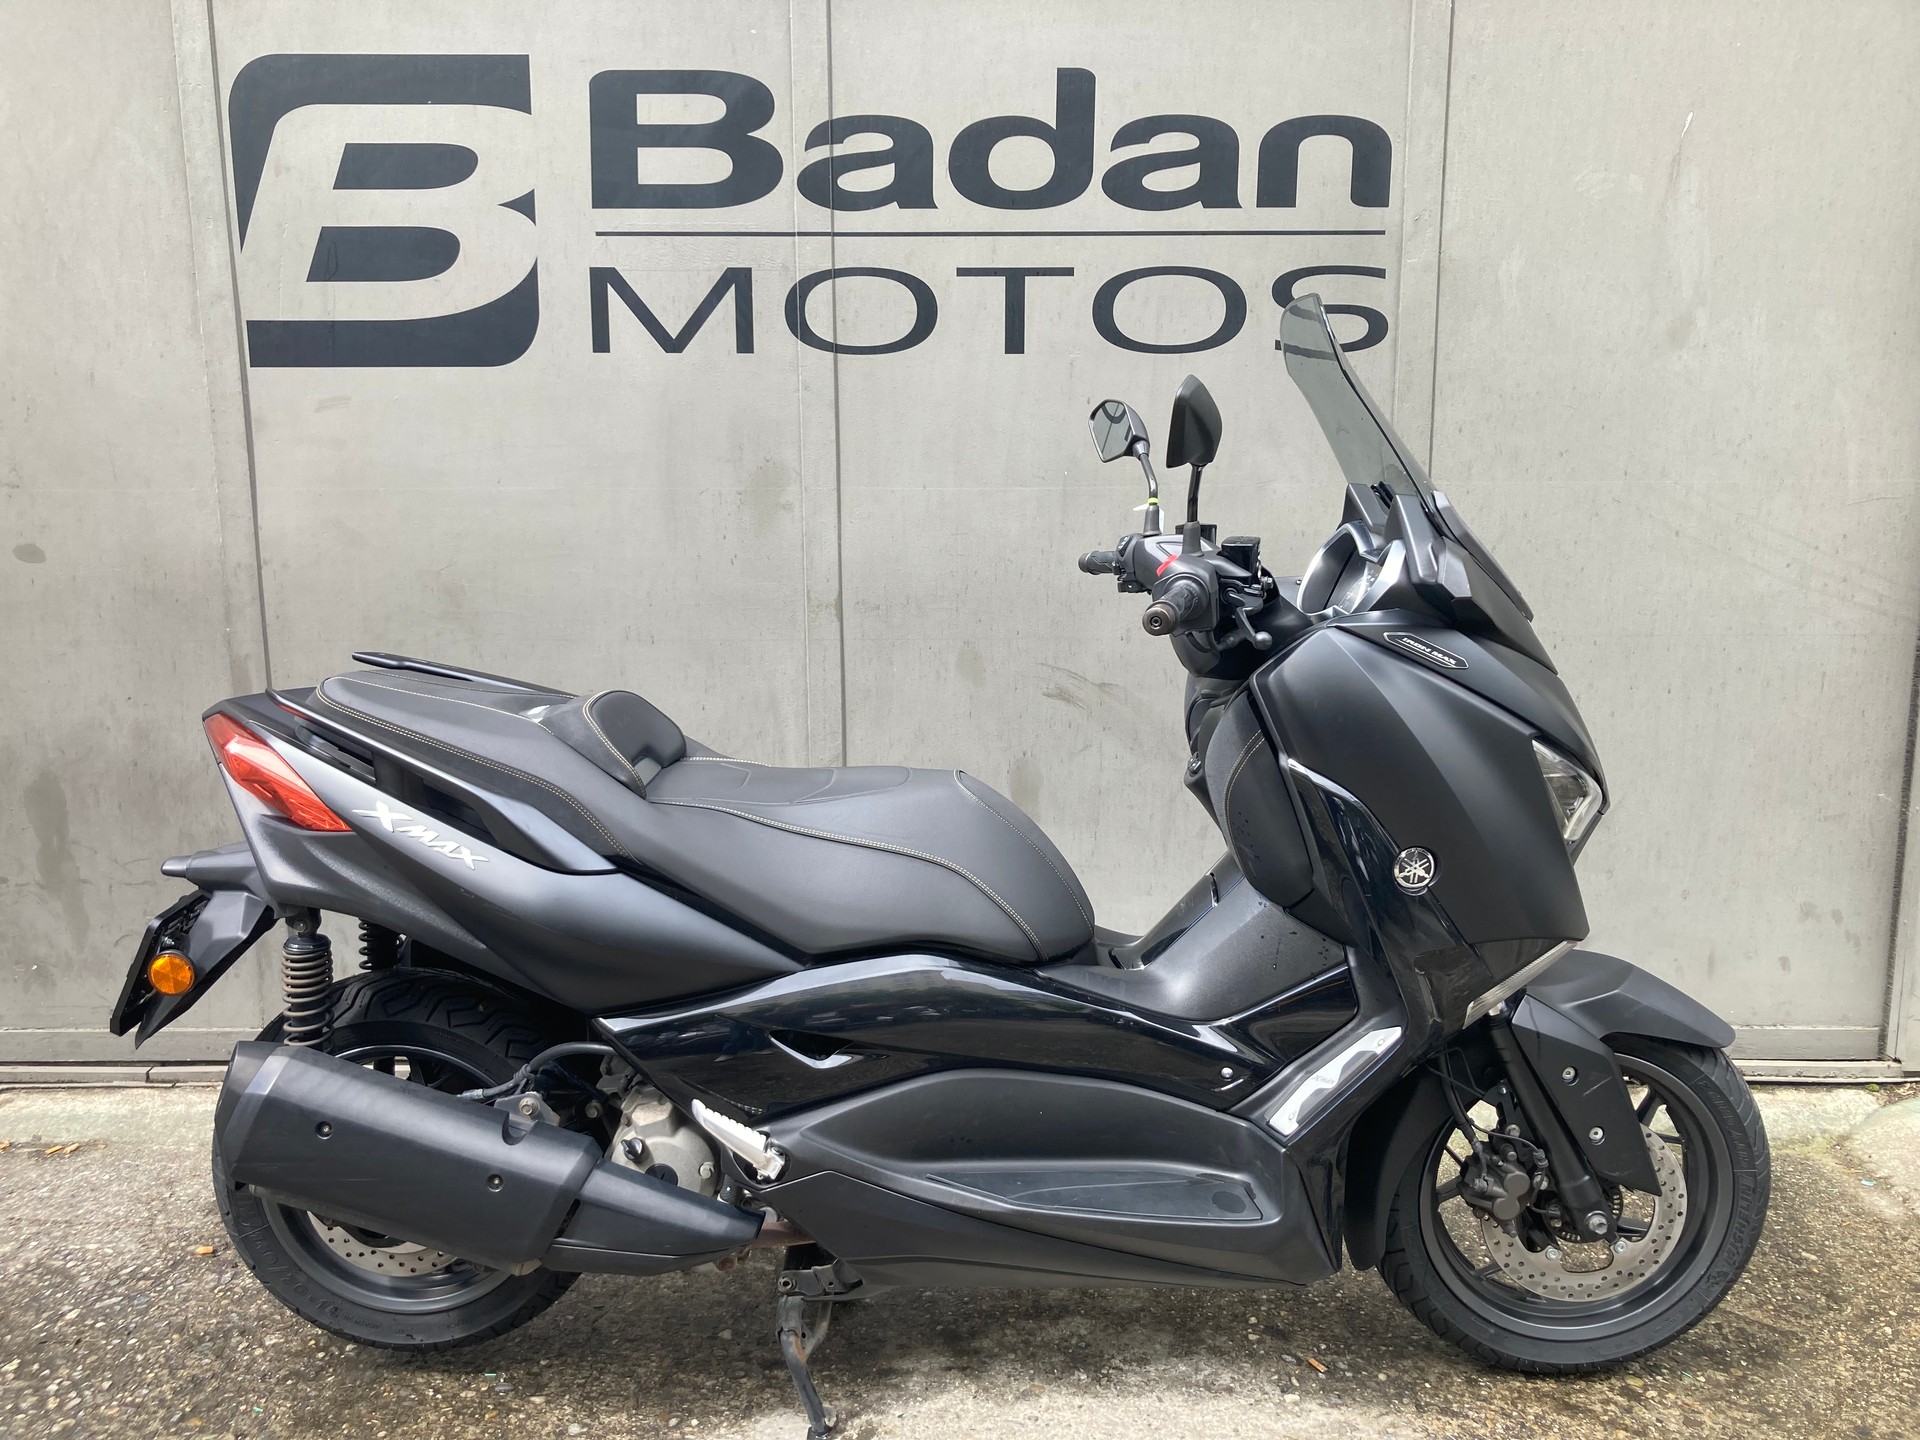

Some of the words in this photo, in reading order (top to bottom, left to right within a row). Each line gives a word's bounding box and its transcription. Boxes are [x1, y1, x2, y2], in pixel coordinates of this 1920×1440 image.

[589, 67, 1392, 212] Badan
[589, 265, 1389, 356] MOTOS
[1402, 637, 1432, 653] IRON
[1431, 650, 1457, 665] MAX
